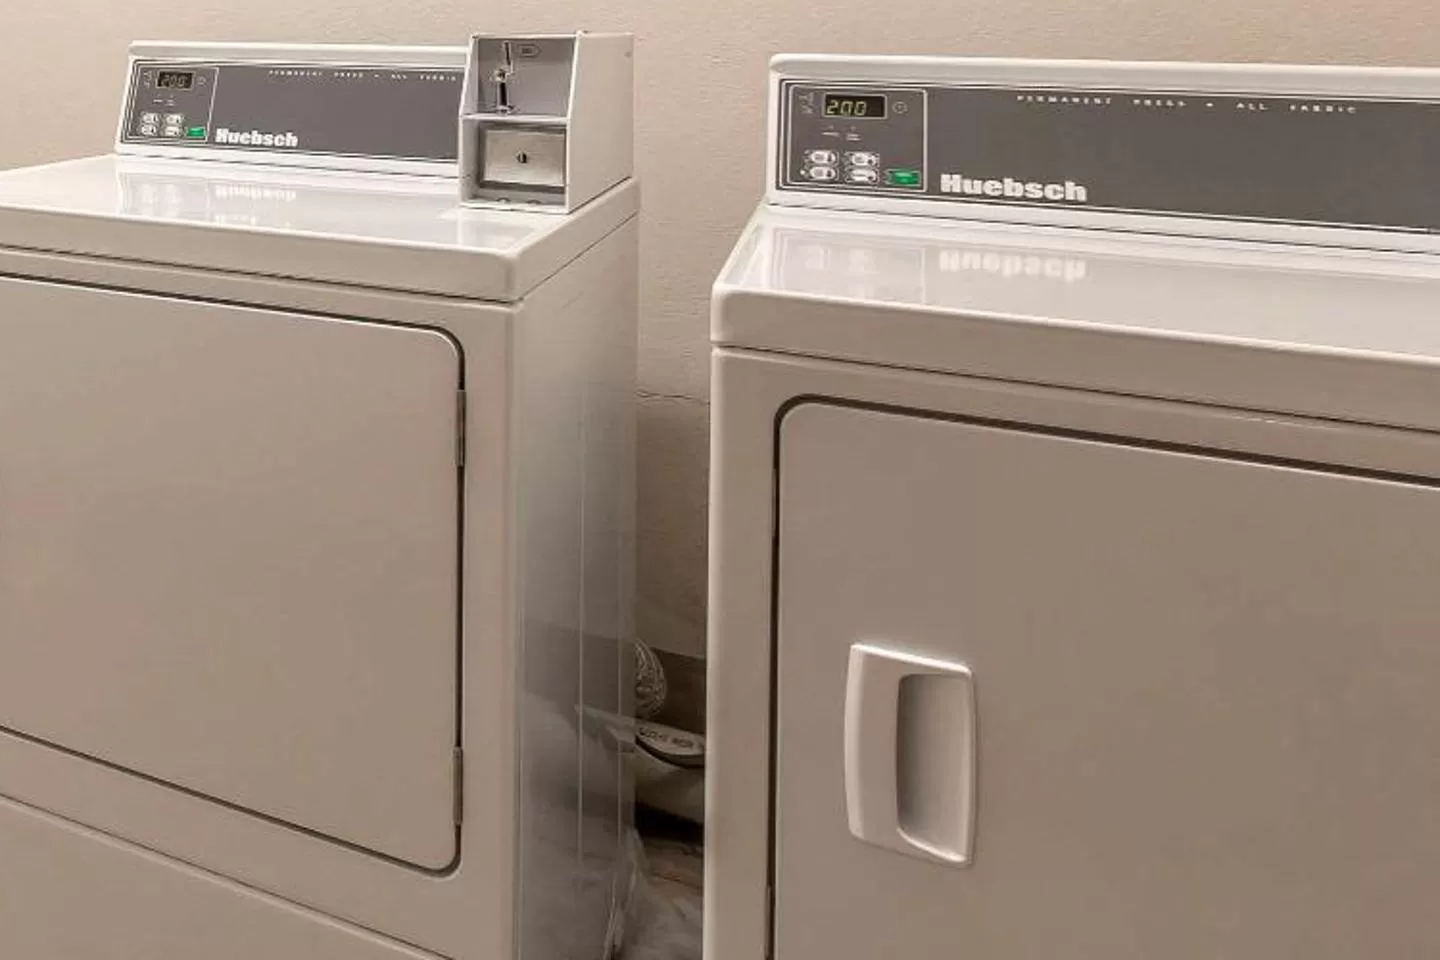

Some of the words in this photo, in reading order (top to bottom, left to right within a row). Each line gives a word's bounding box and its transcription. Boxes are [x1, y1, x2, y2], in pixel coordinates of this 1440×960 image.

[826, 100, 867, 116] 200
[215, 128, 299, 147] Huebsch
[940, 173, 1088, 202] Huebsch
